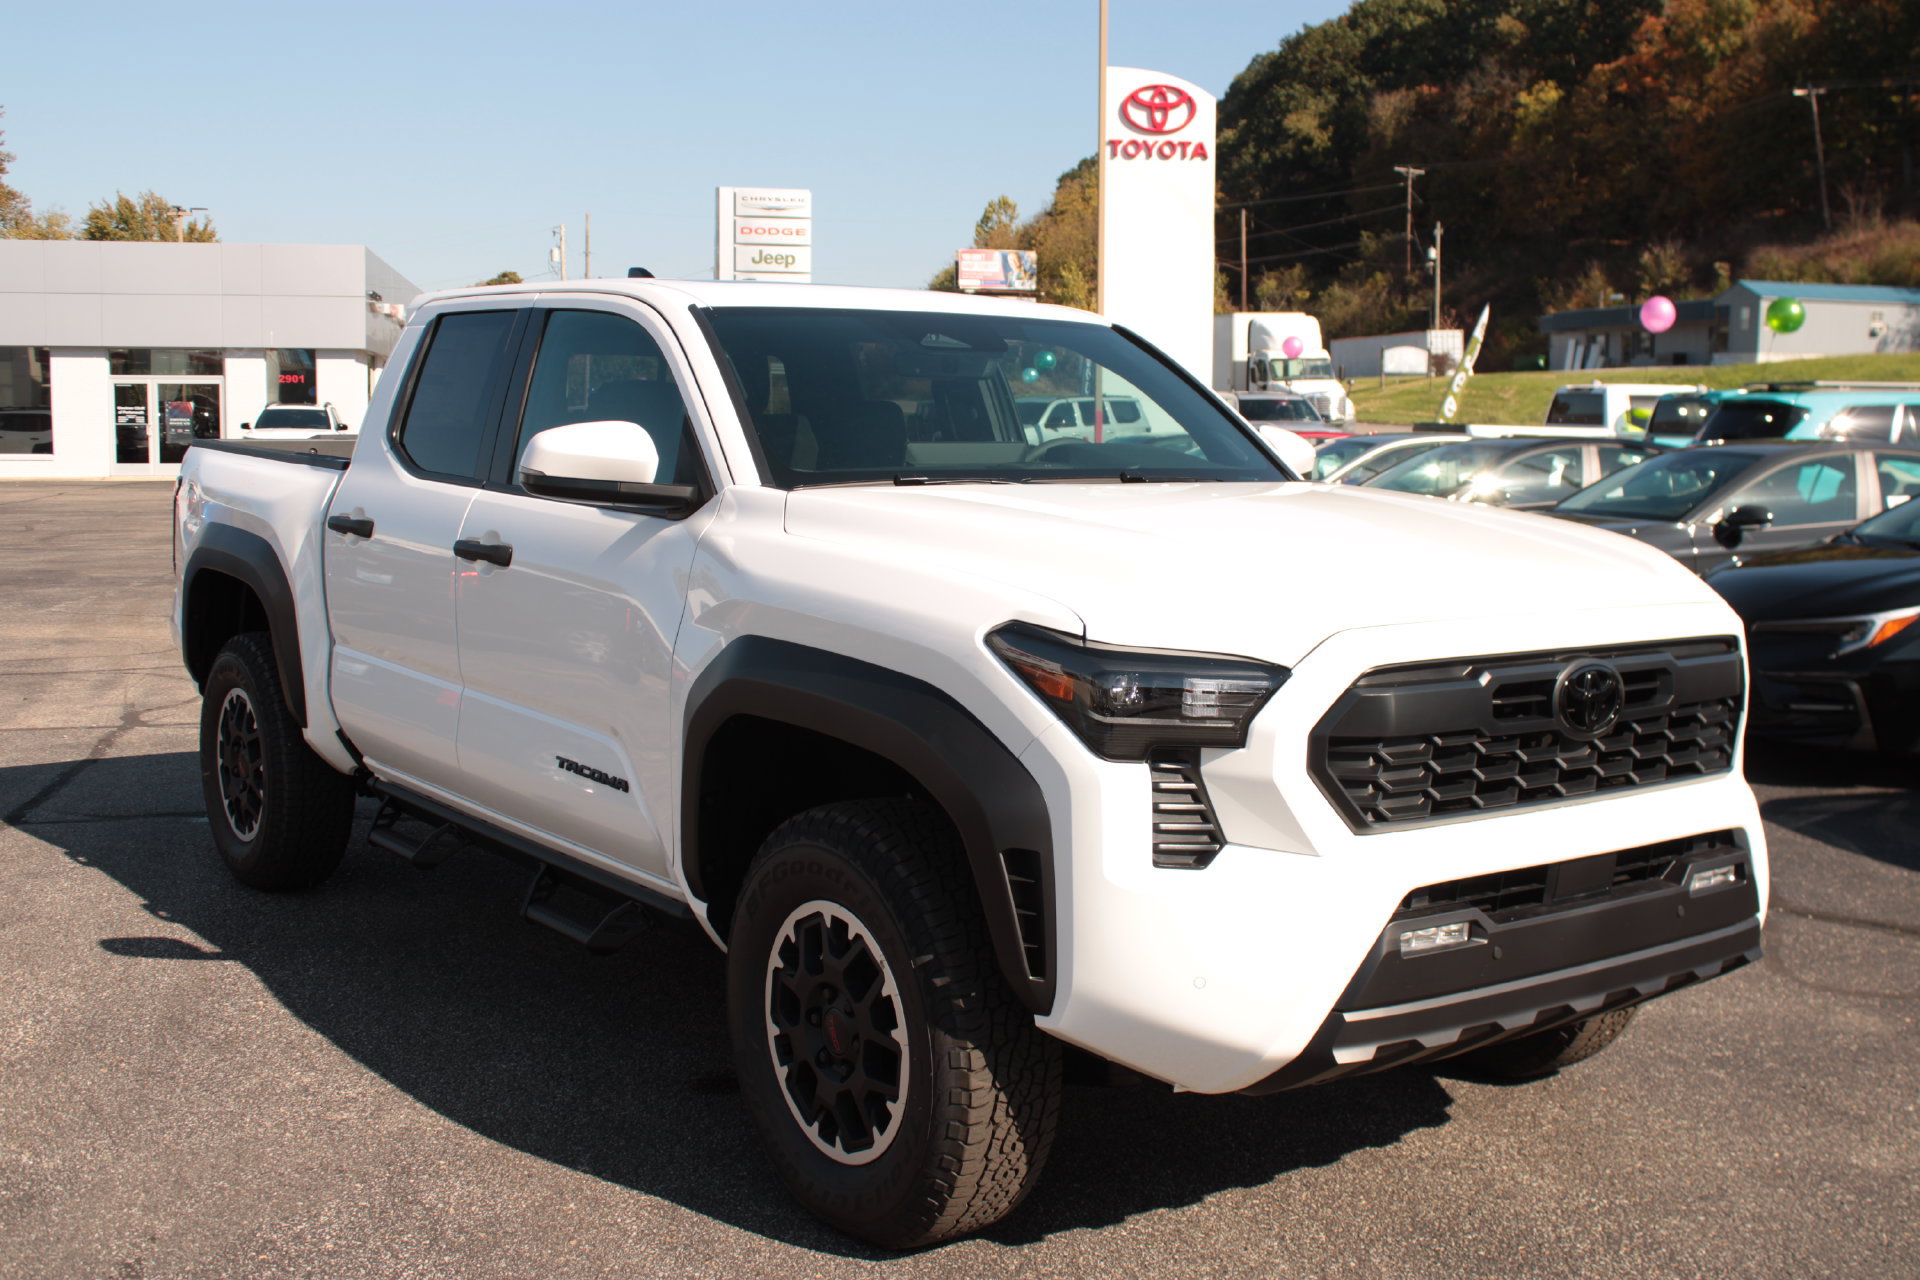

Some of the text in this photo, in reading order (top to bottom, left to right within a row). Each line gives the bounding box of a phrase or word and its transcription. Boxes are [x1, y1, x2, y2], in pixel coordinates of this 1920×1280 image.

[1108, 139, 1208, 161] TOYOTA
[740, 226, 806, 236] DODGE
[751, 249, 796, 268] Jeep
[278, 374, 305, 384] 2901
[555, 756, 629, 792] TACOMA
